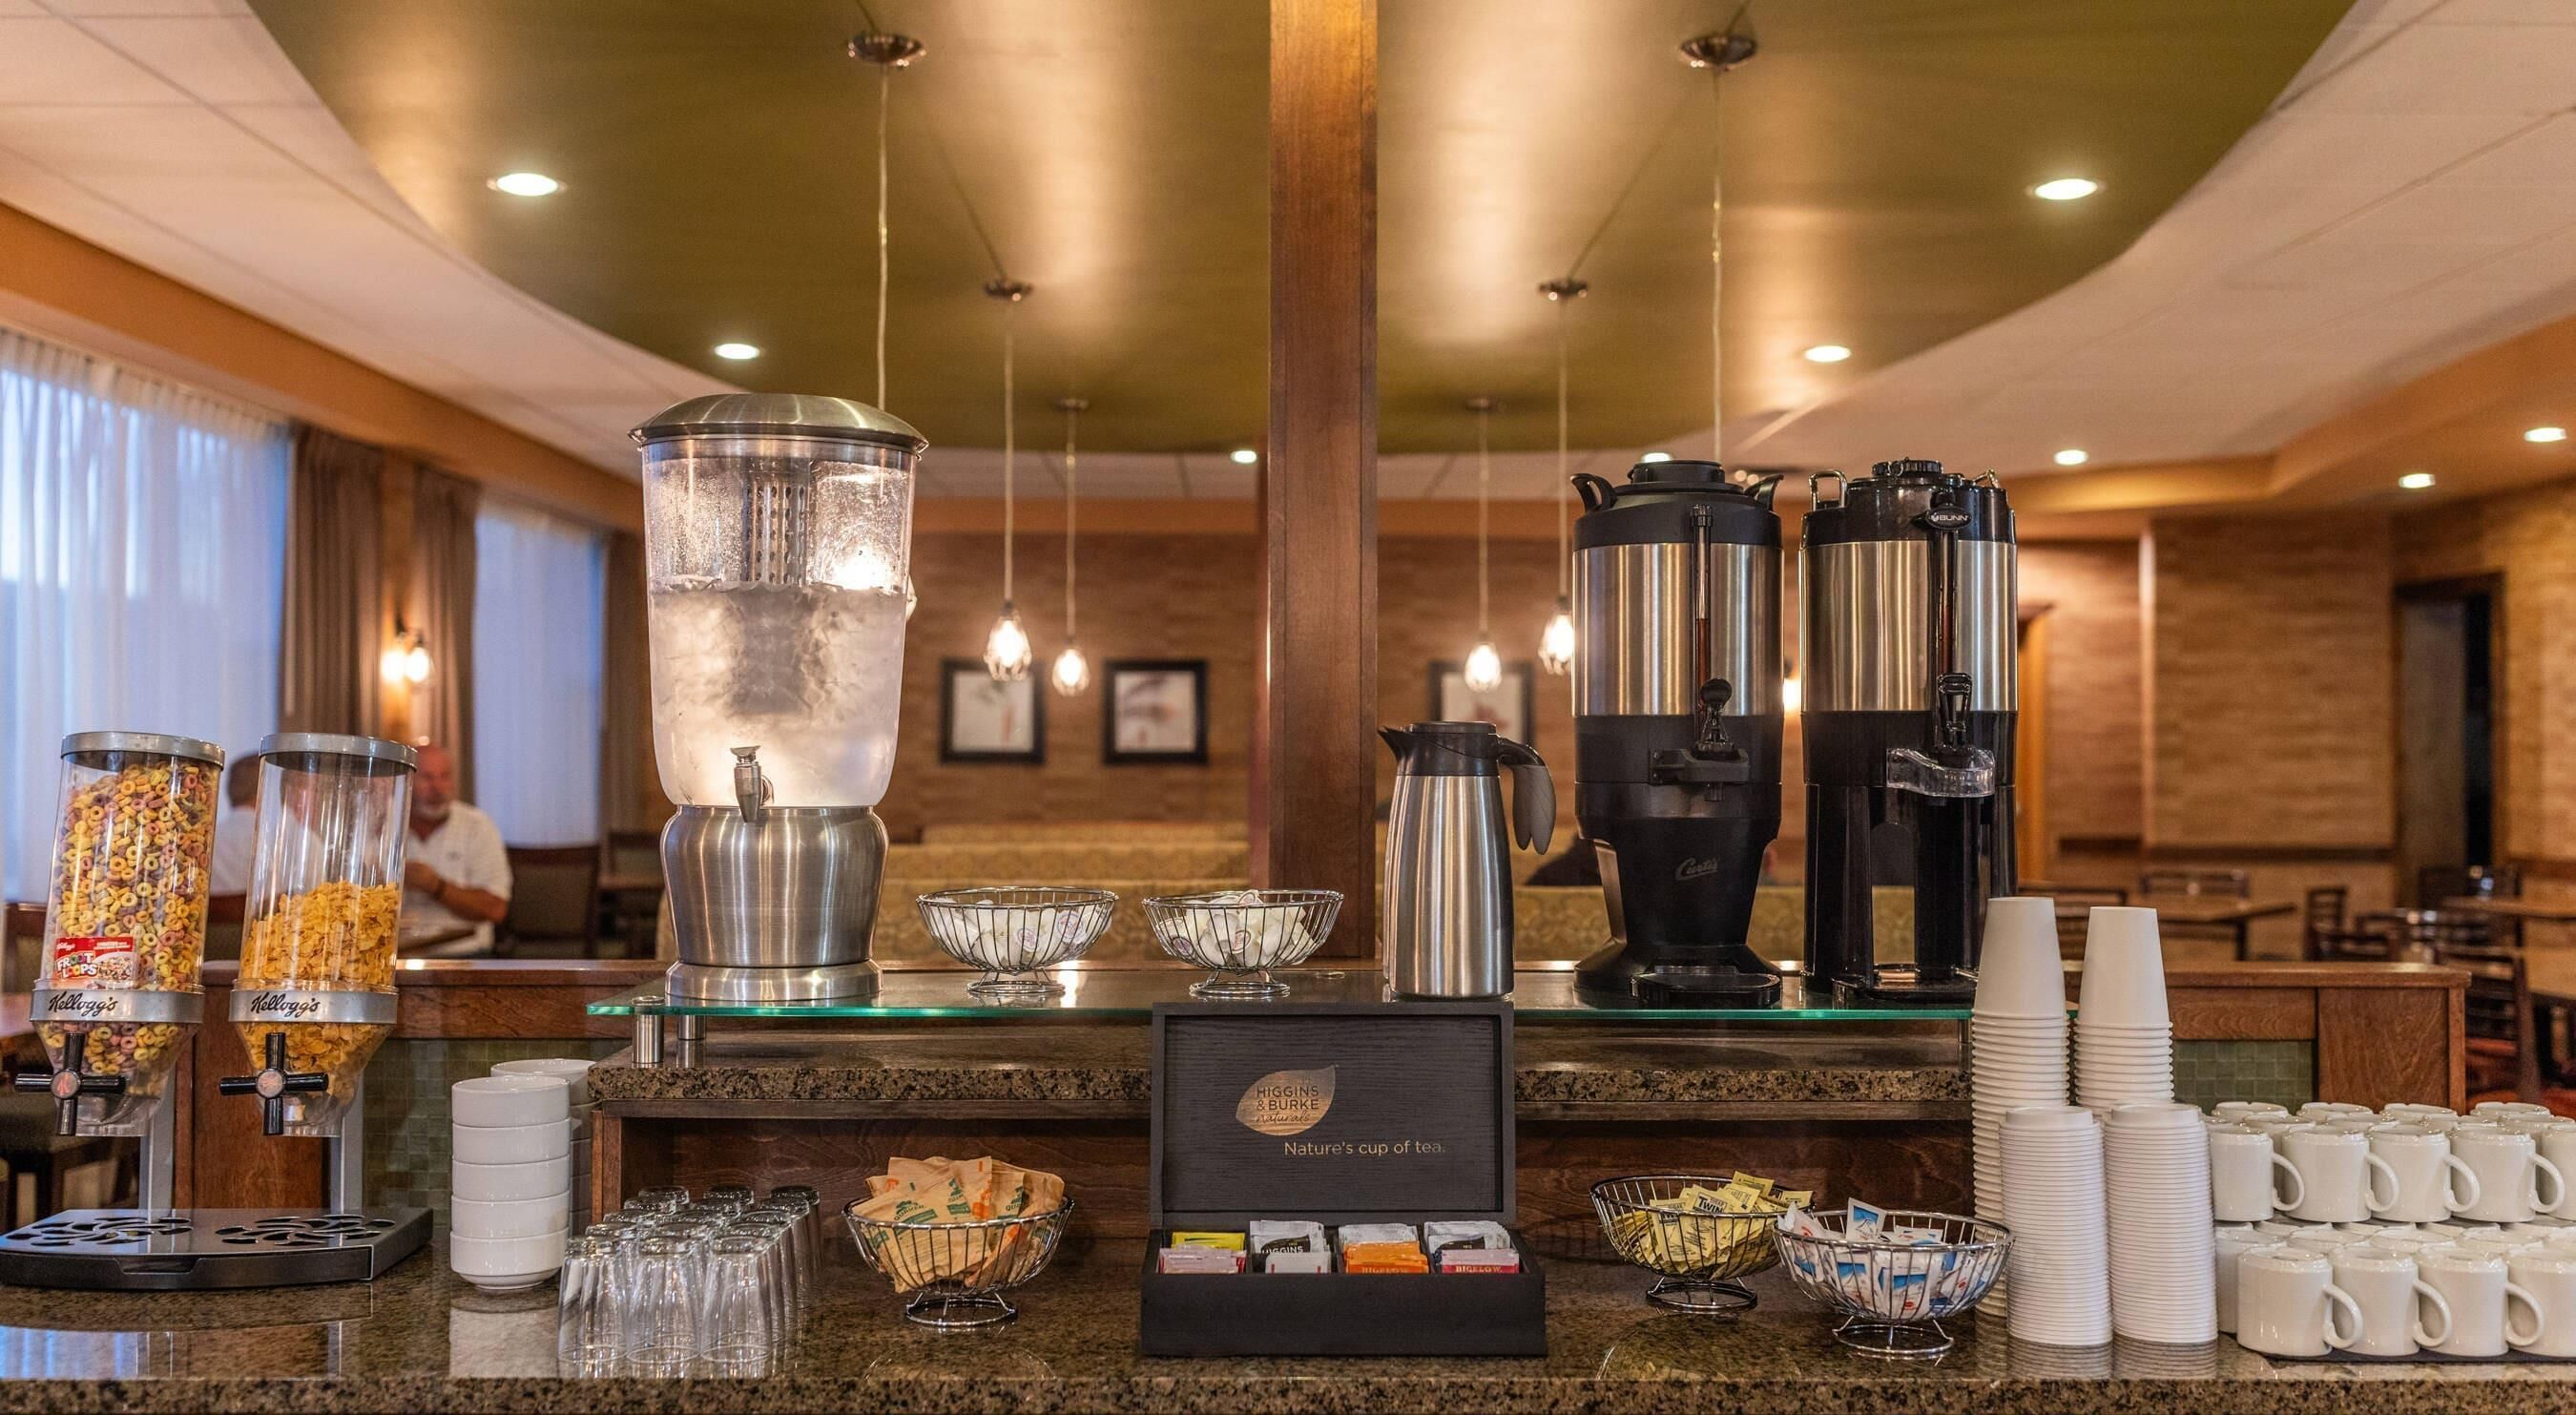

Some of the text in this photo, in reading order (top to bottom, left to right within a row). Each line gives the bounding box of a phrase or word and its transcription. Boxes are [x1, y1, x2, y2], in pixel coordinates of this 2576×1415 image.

[57, 952, 93, 971] FROOT
[62, 964, 97, 978] LOOPS
[48, 990, 118, 1016] Kellogg's
[250, 992, 321, 1018] Kellogg's
[1256, 1086, 1319, 1098] HIGGINS
[1257, 1098, 1319, 1111] & BURKE
[1256, 1110, 1311, 1123] naturals
[1284, 1140, 1446, 1156] Nature's cup of tea.
